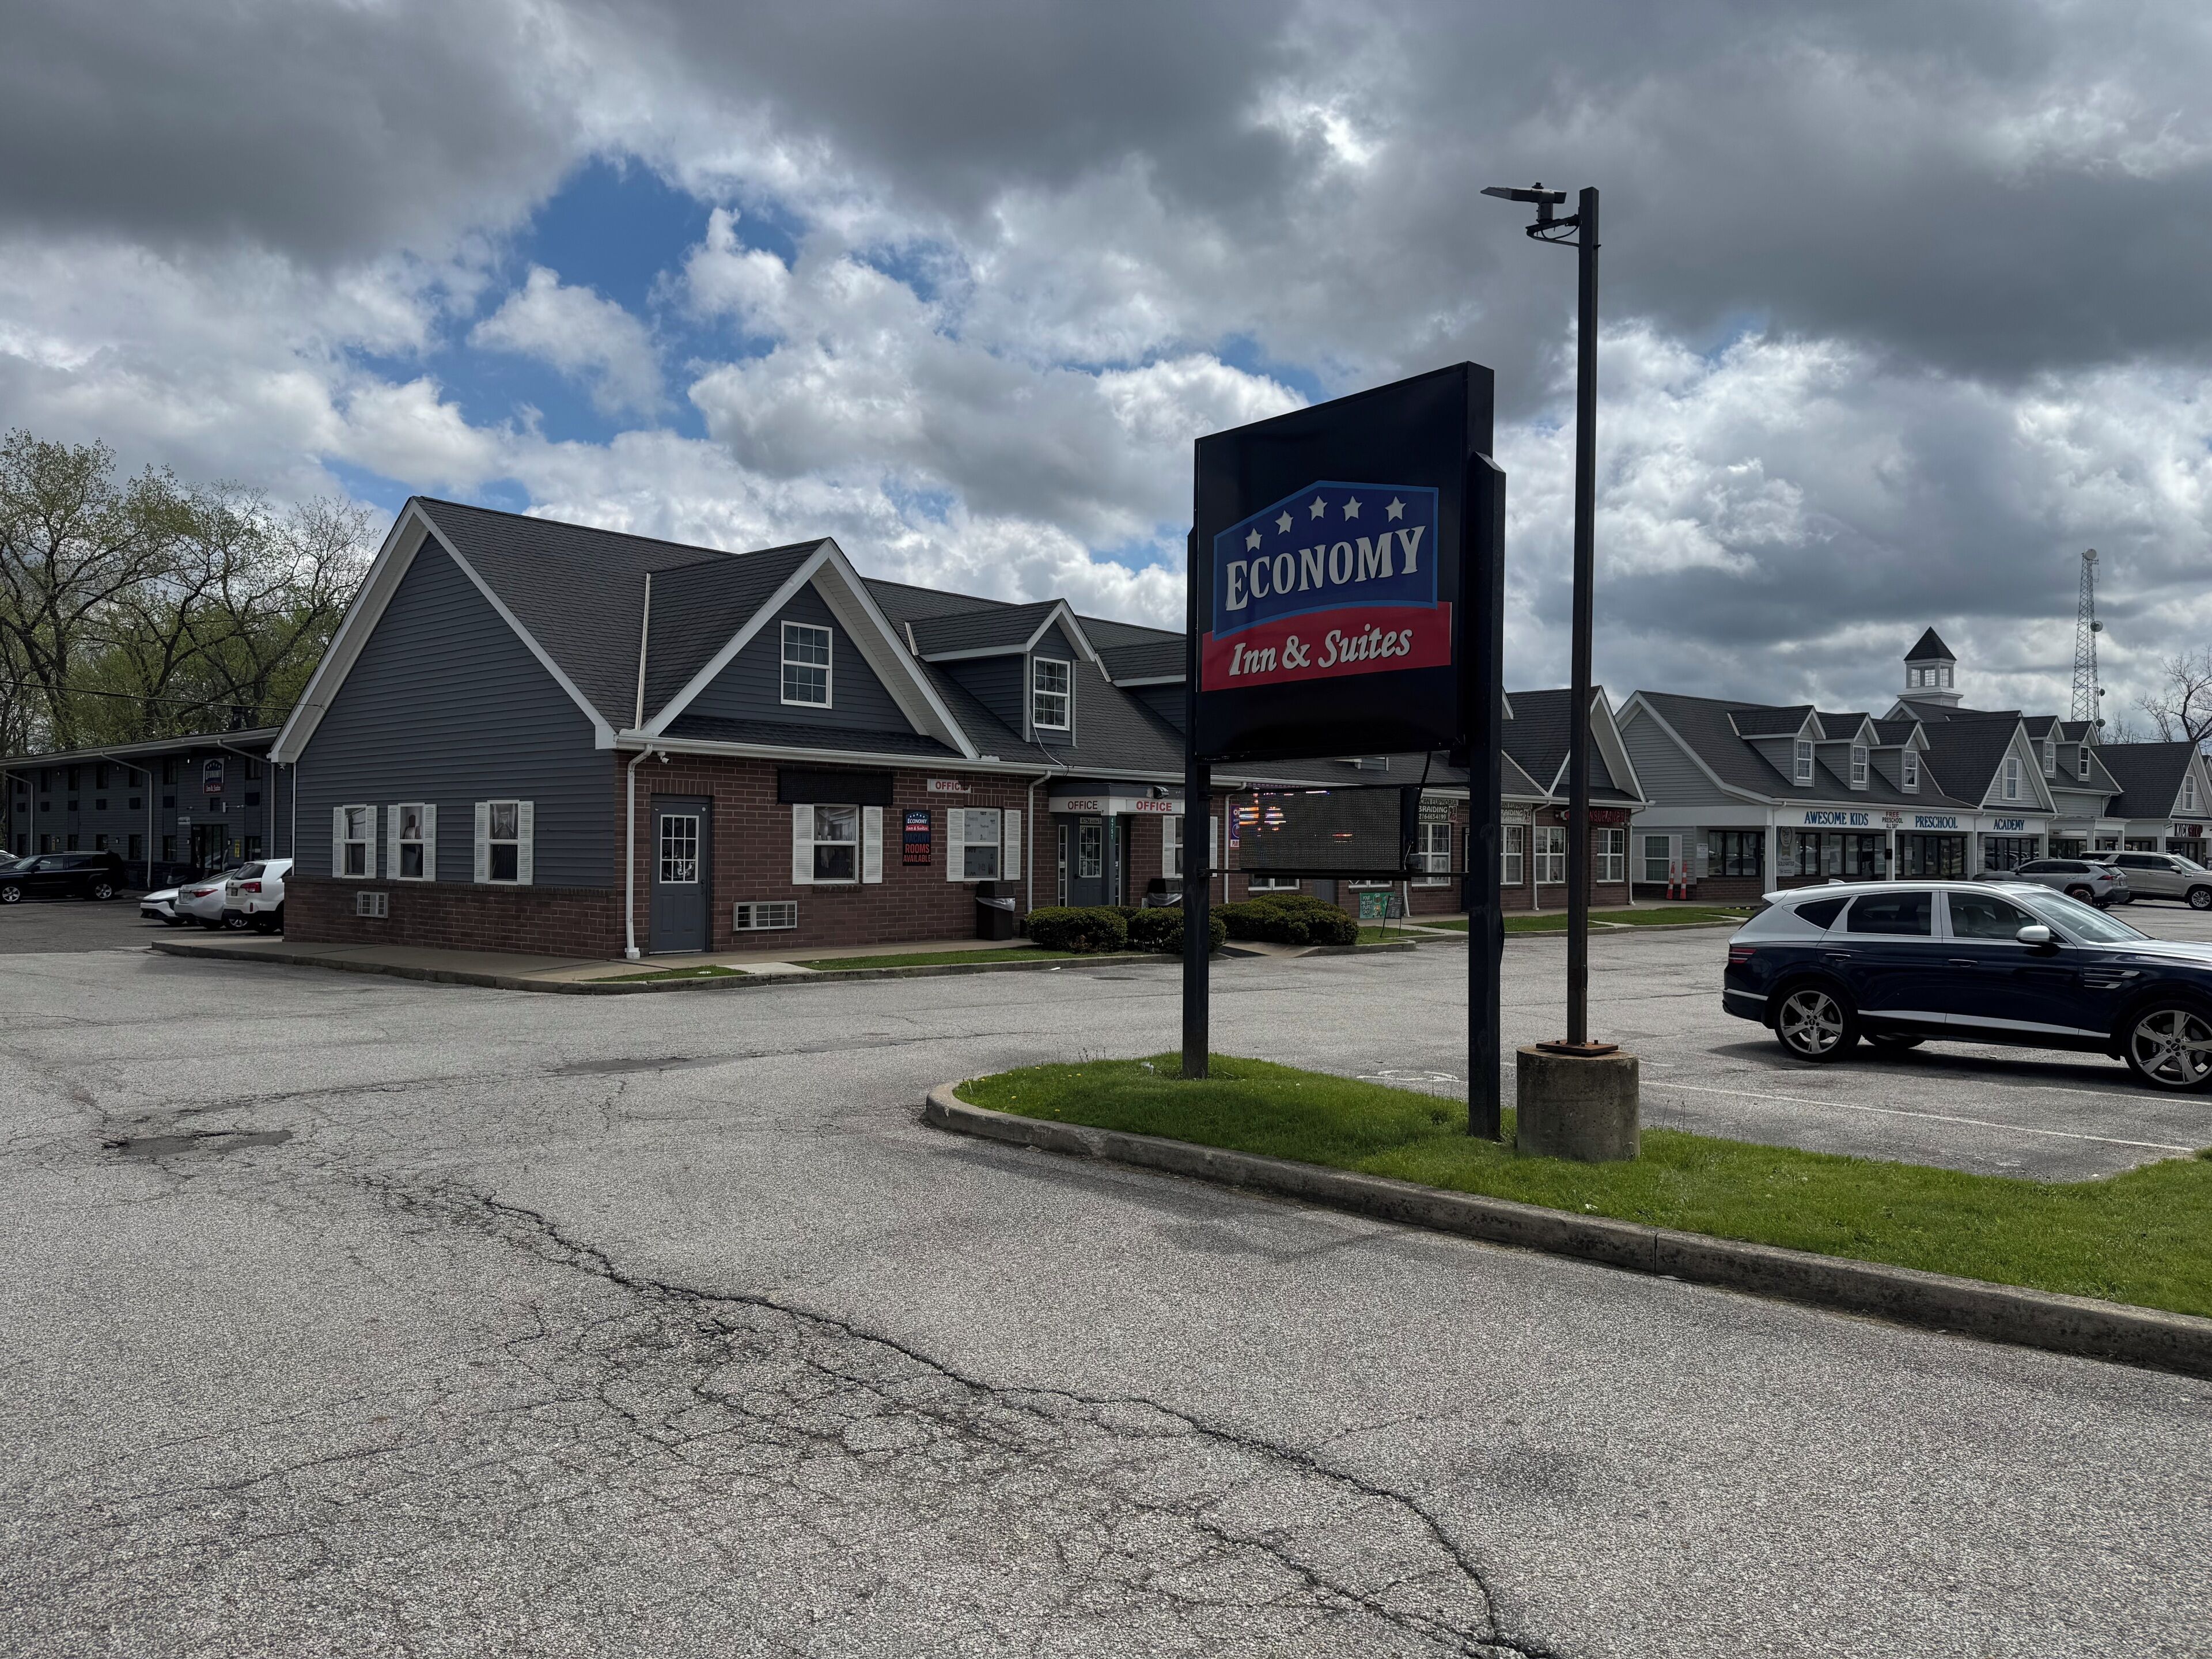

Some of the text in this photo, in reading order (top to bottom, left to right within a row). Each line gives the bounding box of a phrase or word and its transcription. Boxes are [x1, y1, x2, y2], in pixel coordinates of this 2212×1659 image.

[1226, 525, 1426, 611] ECONOMY
[1229, 623, 1413, 677] Inn & Suites
[935, 781, 965, 791] OFFIC
[1067, 801, 1098, 810] OFFICE
[1136, 801, 1172, 811] OFFICE
[1589, 810, 1624, 822] NSURANCE
[1804, 811, 2025, 831] AWESOME KIDS PRESCHOOL ACADEMY
[905, 843, 930, 854] ROOMS
[903, 854, 931, 862] AVAILABLE
